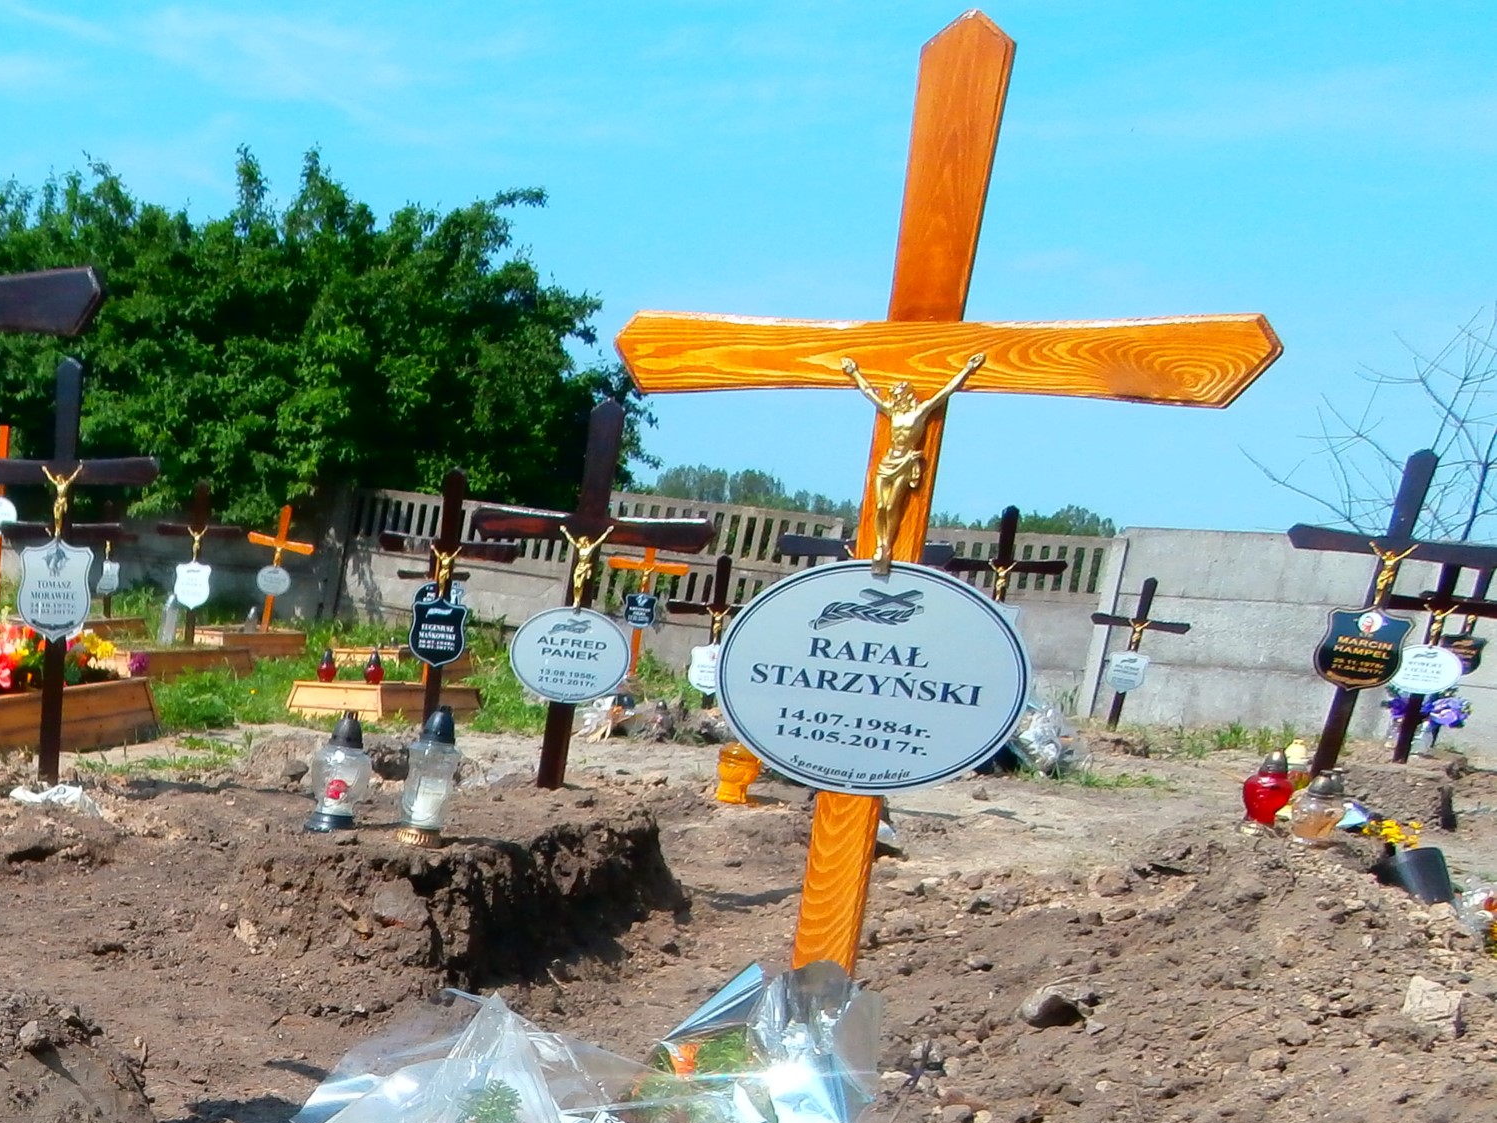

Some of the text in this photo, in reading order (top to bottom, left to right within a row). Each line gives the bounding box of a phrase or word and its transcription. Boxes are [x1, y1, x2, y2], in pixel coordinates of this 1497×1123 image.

[38, 580, 72, 589] TOMASZ
[30, 590, 75, 600] MORAWIEC
[537, 635, 608, 651] ALFRED
[1337, 635, 1393, 651] MARCIN
[541, 647, 600, 661] PANEK
[807, 637, 930, 668] RAFAŁ
[1333, 644, 1390, 660] HAMPEL
[750, 662, 983, 708] STARZYŃSKI
[778, 707, 932, 739] 14.07.1984r.
[774, 724, 928, 757] 14.05.2017r.
[868, 768, 911, 782] pokoju
